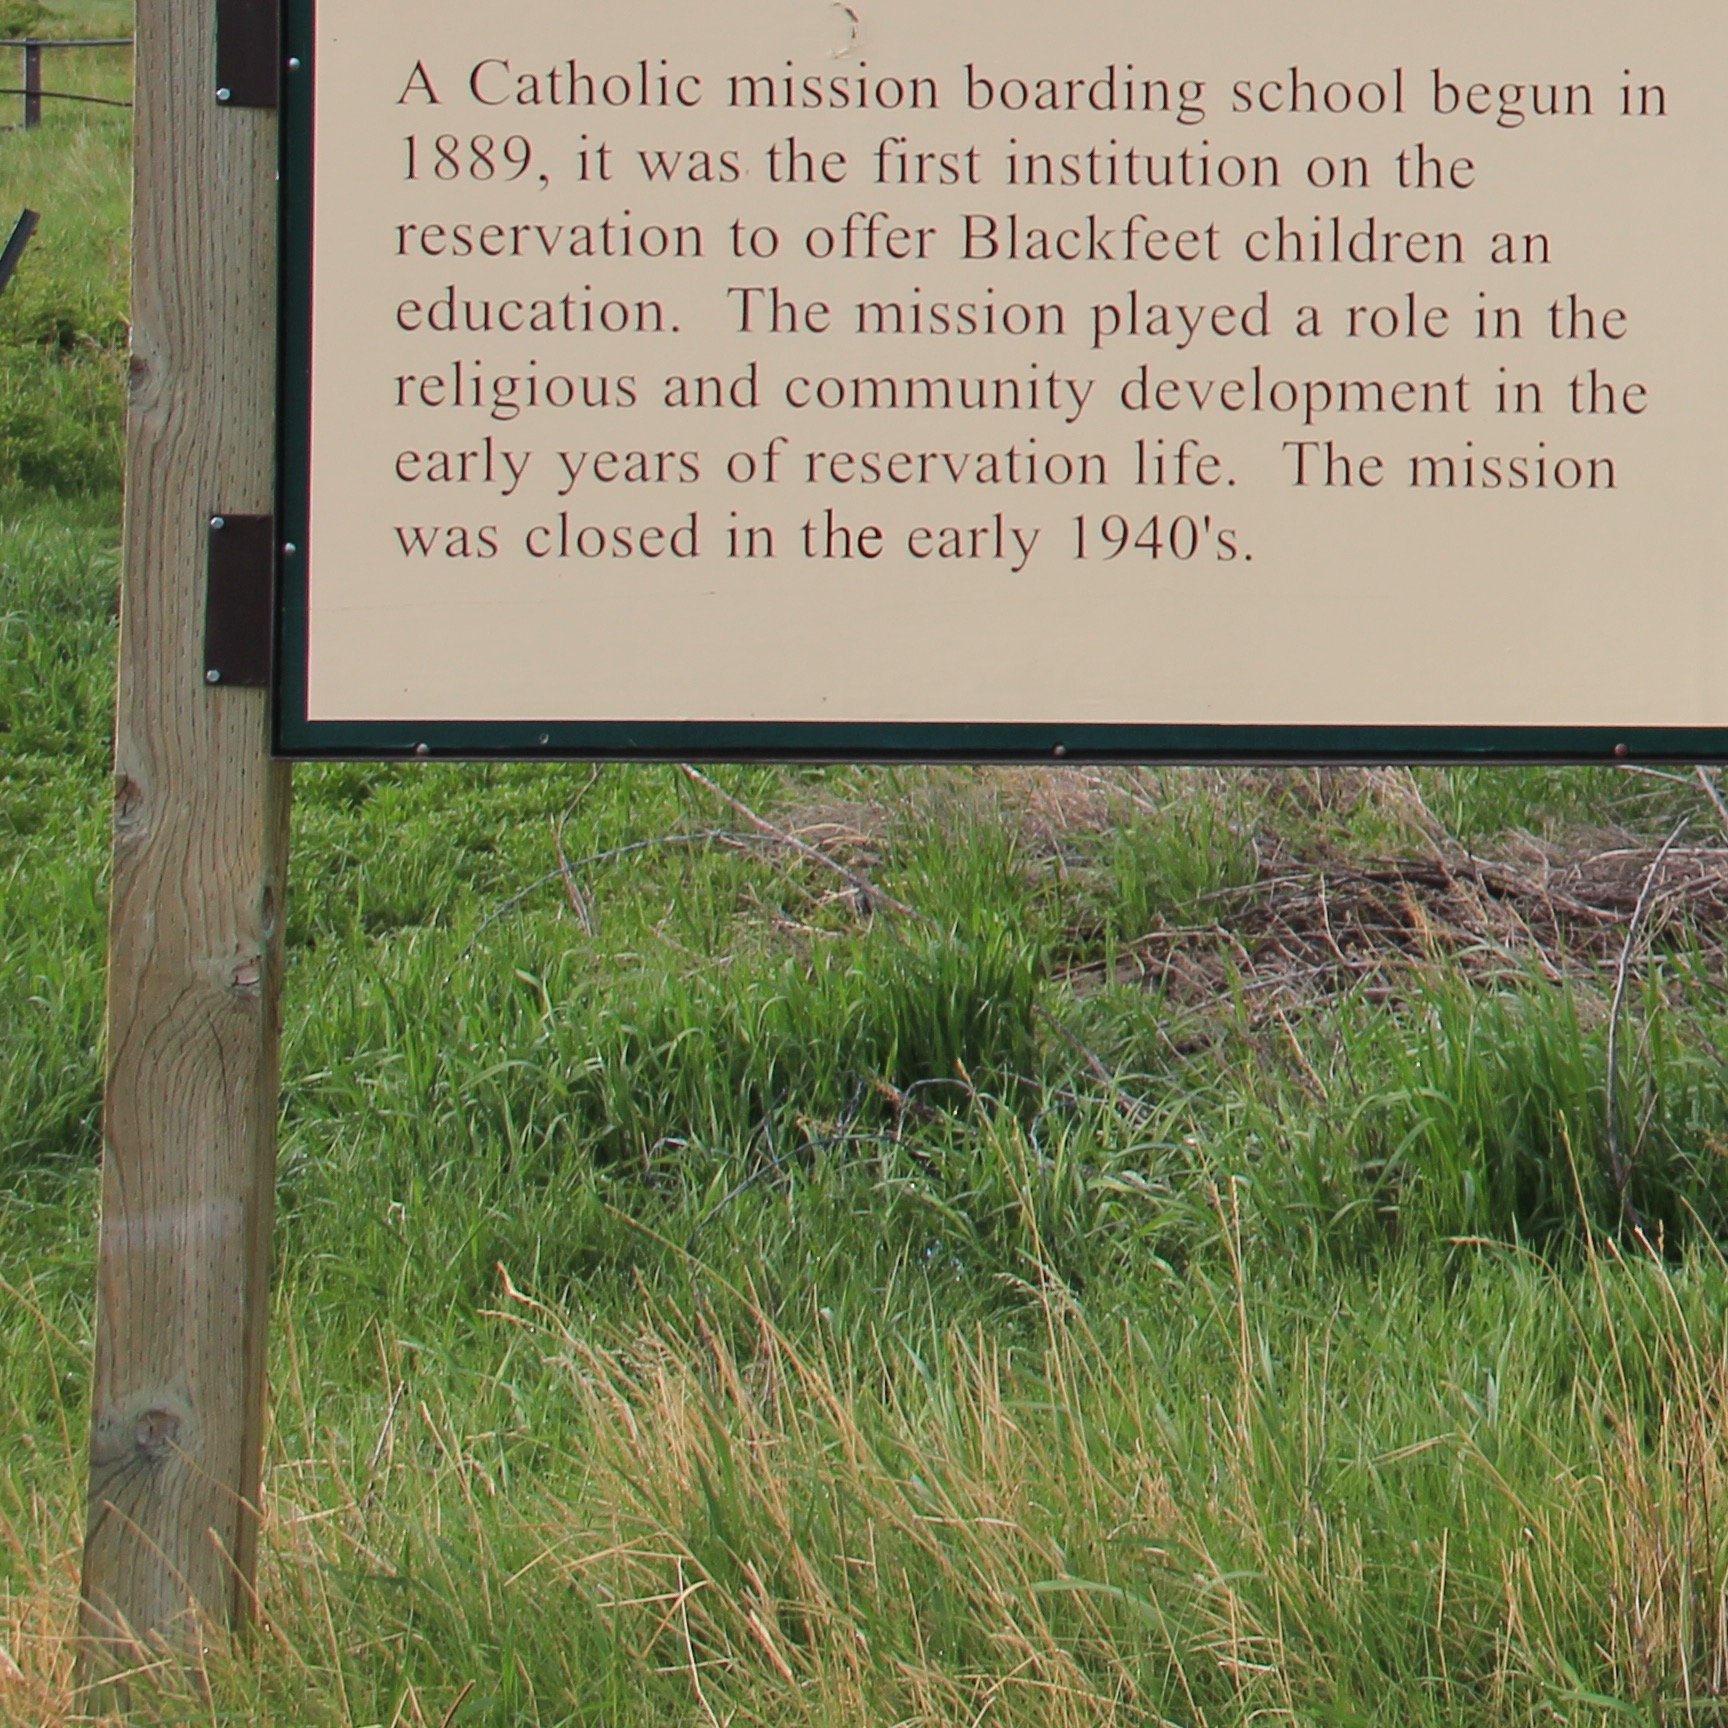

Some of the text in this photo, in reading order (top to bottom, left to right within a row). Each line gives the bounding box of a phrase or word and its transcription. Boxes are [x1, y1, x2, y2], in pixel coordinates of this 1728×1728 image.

[396, 58, 1667, 129] A Catholic mission boarding school begun in
[404, 133, 1475, 191] 1889, it was the first institution on the
[395, 209, 1552, 265] reservation to offer Blackfeet children an
[396, 284, 1627, 351] education. The mission played a role in the
[394, 359, 1647, 426] religious and community development in the
[395, 435, 1616, 497] early years of reservation life. The mission
[393, 507, 1253, 574] was closed in the early 1940's.
